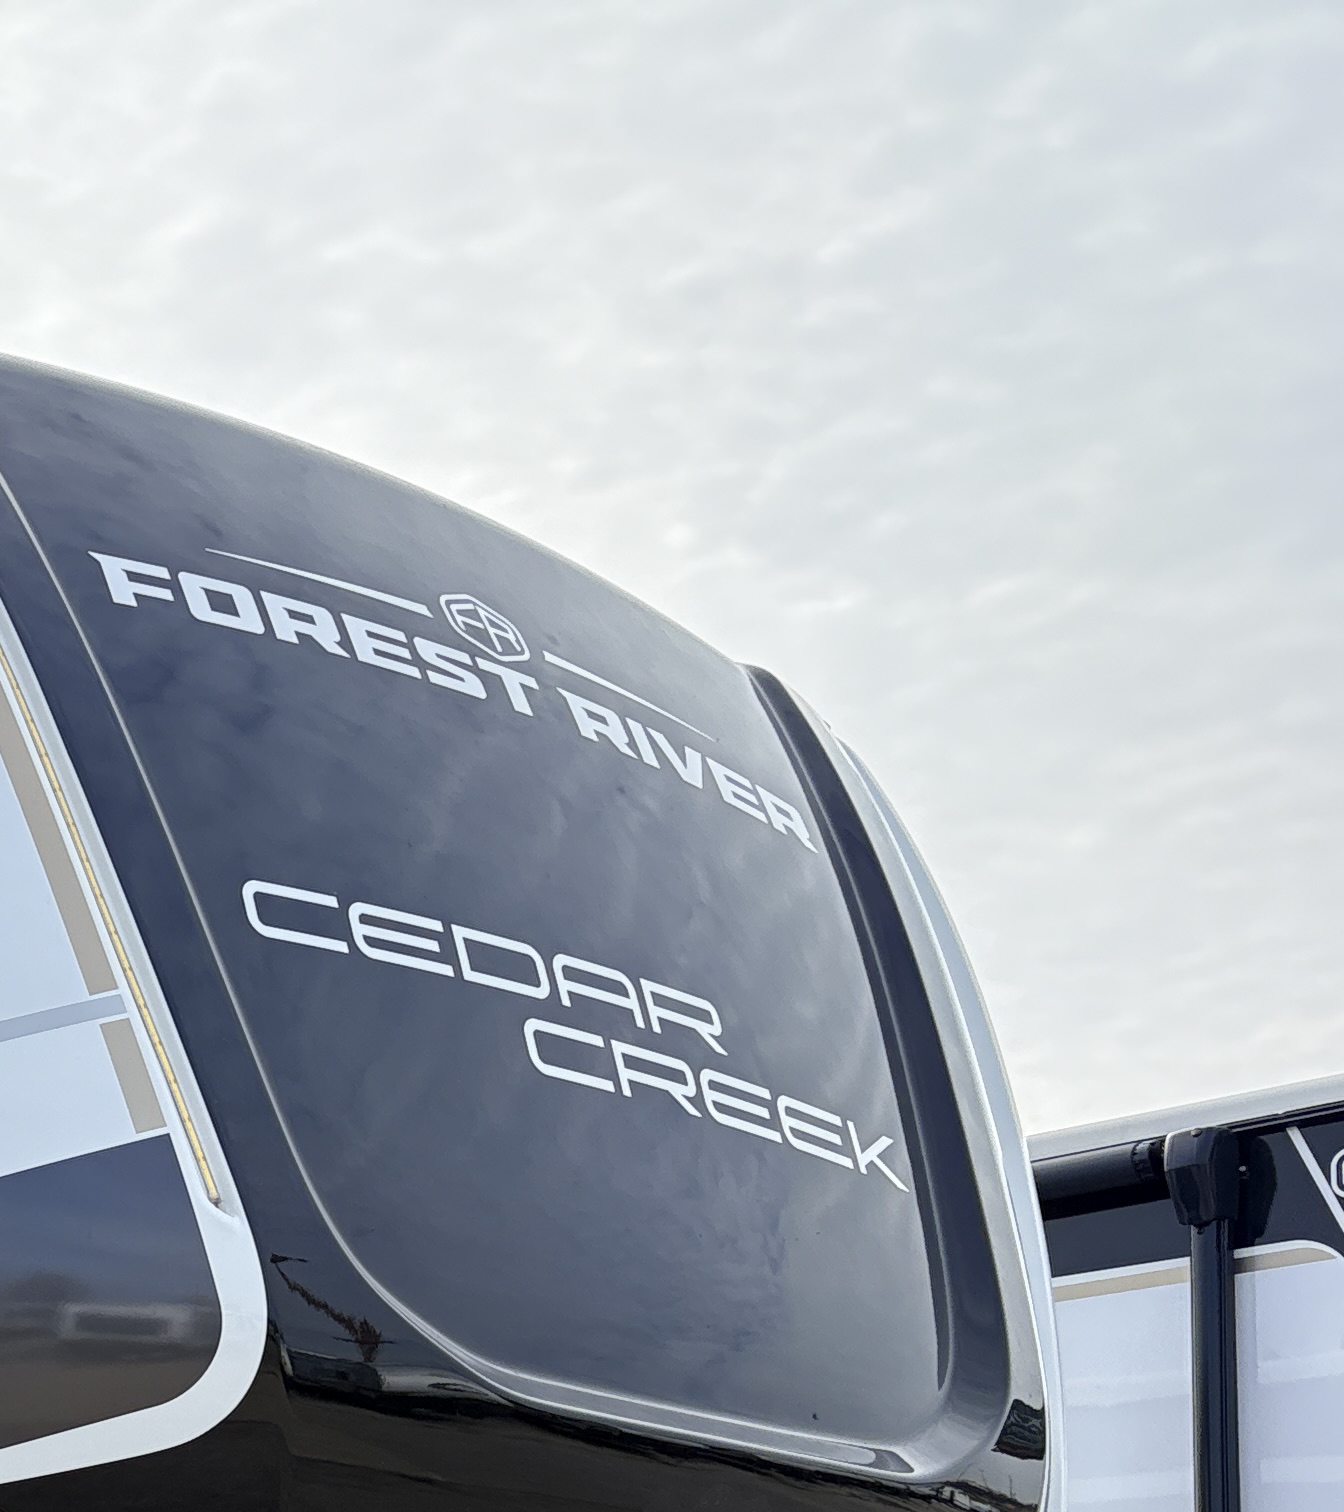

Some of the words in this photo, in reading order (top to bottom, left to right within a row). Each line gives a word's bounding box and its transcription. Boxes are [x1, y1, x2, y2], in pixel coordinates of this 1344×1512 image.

[87, 550, 540, 717] FOREST
[555, 686, 820, 854] RIVER
[241, 879, 729, 1057] CEDAR
[523, 1017, 910, 1193] CREEK
